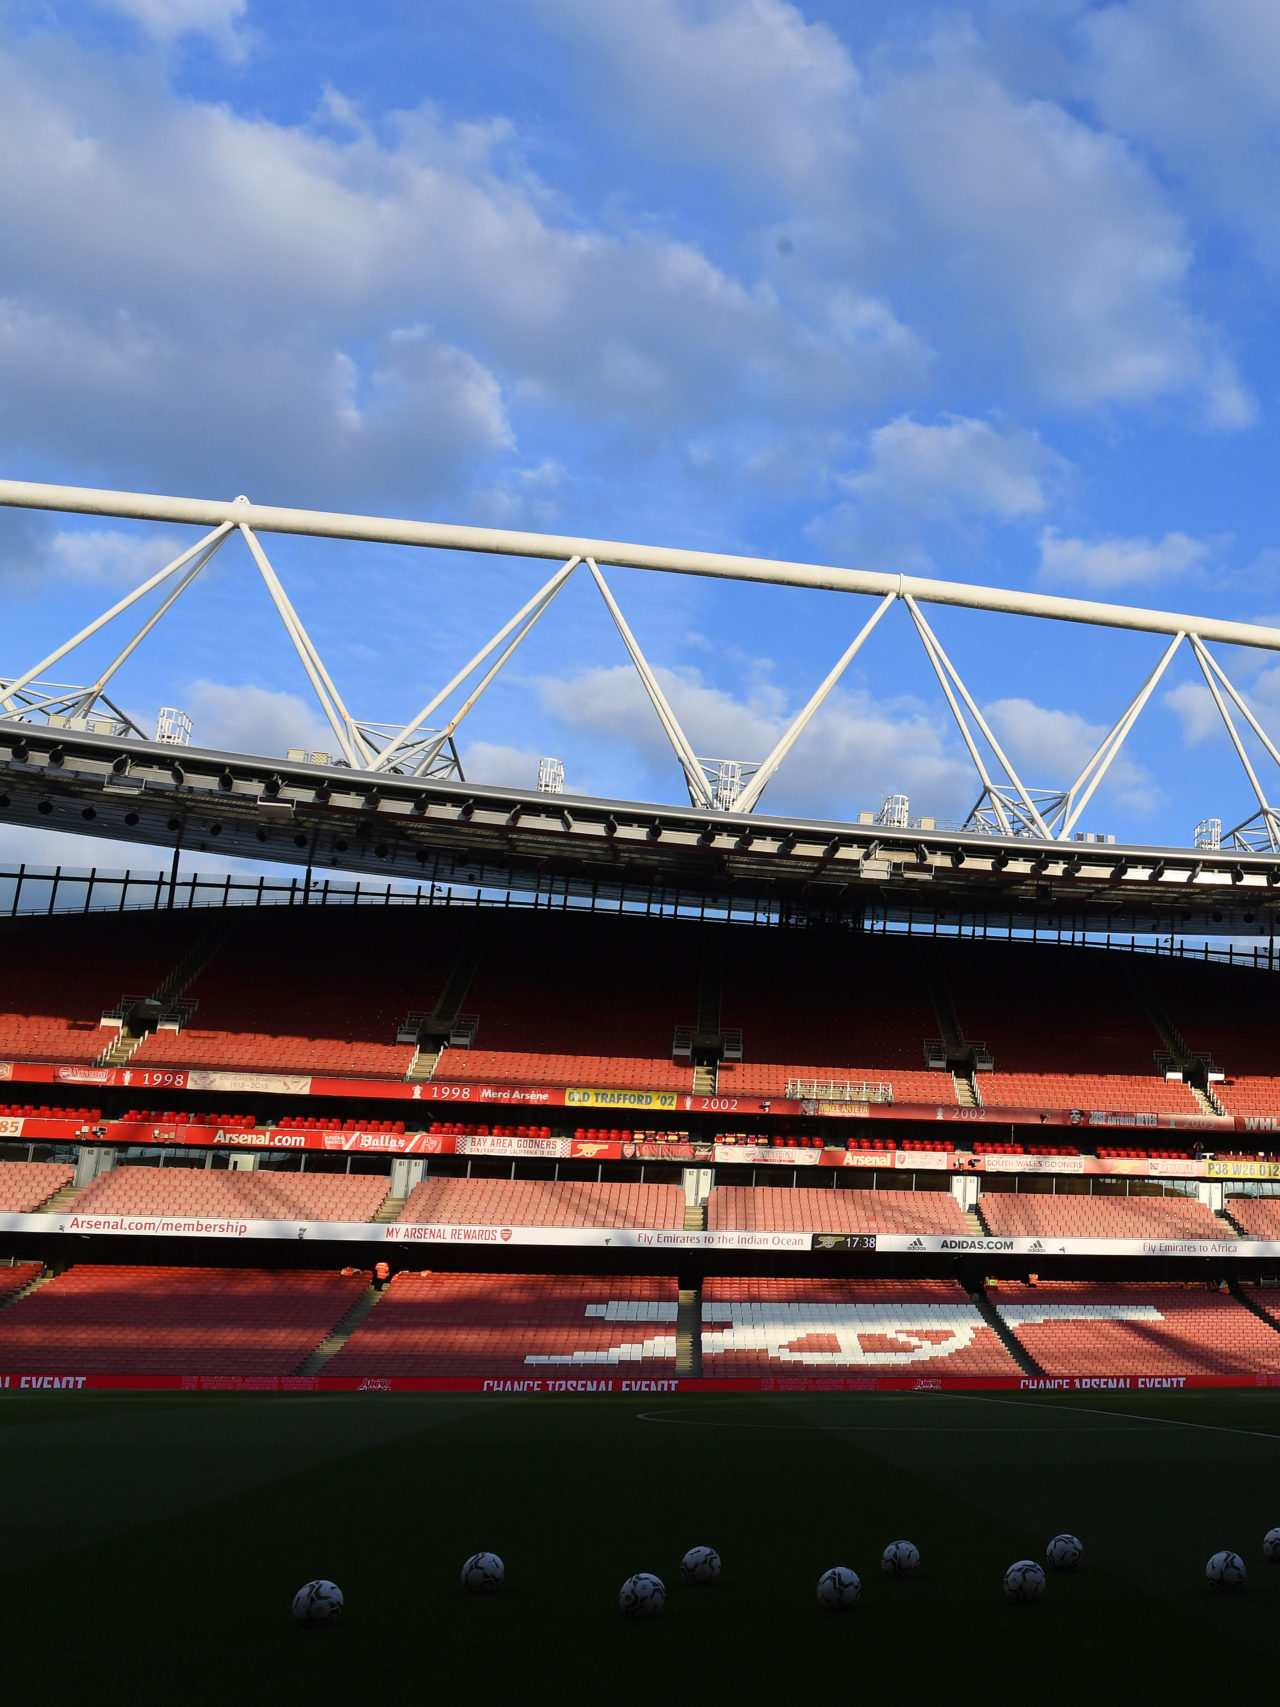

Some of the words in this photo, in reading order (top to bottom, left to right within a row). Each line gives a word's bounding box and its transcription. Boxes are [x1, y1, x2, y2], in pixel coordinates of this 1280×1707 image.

[142, 1073, 184, 1087] 1998
[431, 1087, 471, 1099] 1998
[481, 1089, 510, 1098] Merci
[512, 1090, 549, 1100] Arsène
[567, 1090, 590, 1103] OLD
[593, 1092, 653, 1106] TRAFFORD
[701, 1097, 738, 1110] 2002
[818, 1103, 839, 1112] MIKEL
[841, 1104, 868, 1113] ARTETA
[952, 1108, 986, 1120] 2002
[1107, 1115, 1135, 1125] ANTONIO
[1136, 1112, 1158, 1127] REYES
[1244, 1117, 1280, 1131] WHL
[213, 1129, 305, 1147] Arsenal.com
[360, 1133, 405, 1148] Dallas
[470, 1137, 487, 1147] BAY
[490, 1138, 513, 1148] AREA
[517, 1139, 557, 1150] GOONERS
[842, 1151, 891, 1167] Arsenal
[986, 1159, 1014, 1167] SOUTH
[1016, 1159, 1043, 1168] WALES
[1207, 1162, 1229, 1175] P38
[1232, 1163, 1256, 1176] W26
[1259, 1164, 1280, 1177] D12
[69, 1216, 248, 1235] Arsenal.com/membership
[385, 1227, 400, 1239] MY
[403, 1228, 448, 1240] ARSENAL
[450, 1229, 498, 1242] REWARDS
[637, 1233, 653, 1246] Fly
[657, 1233, 701, 1244] Emirates
[703, 1235, 715, 1245] to
[717, 1234, 734, 1245] the
[736, 1234, 768, 1246] Indian
[771, 1235, 804, 1247] Ocean
[845, 1235, 876, 1249] 17:38
[940, 1239, 1014, 1251] ADIDAS.COM
[1143, 1243, 1156, 1255] Fly
[1158, 1242, 1197, 1253] Emirates
[1198, 1244, 1209, 1253] to
[1211, 1242, 1238, 1254] Africa
